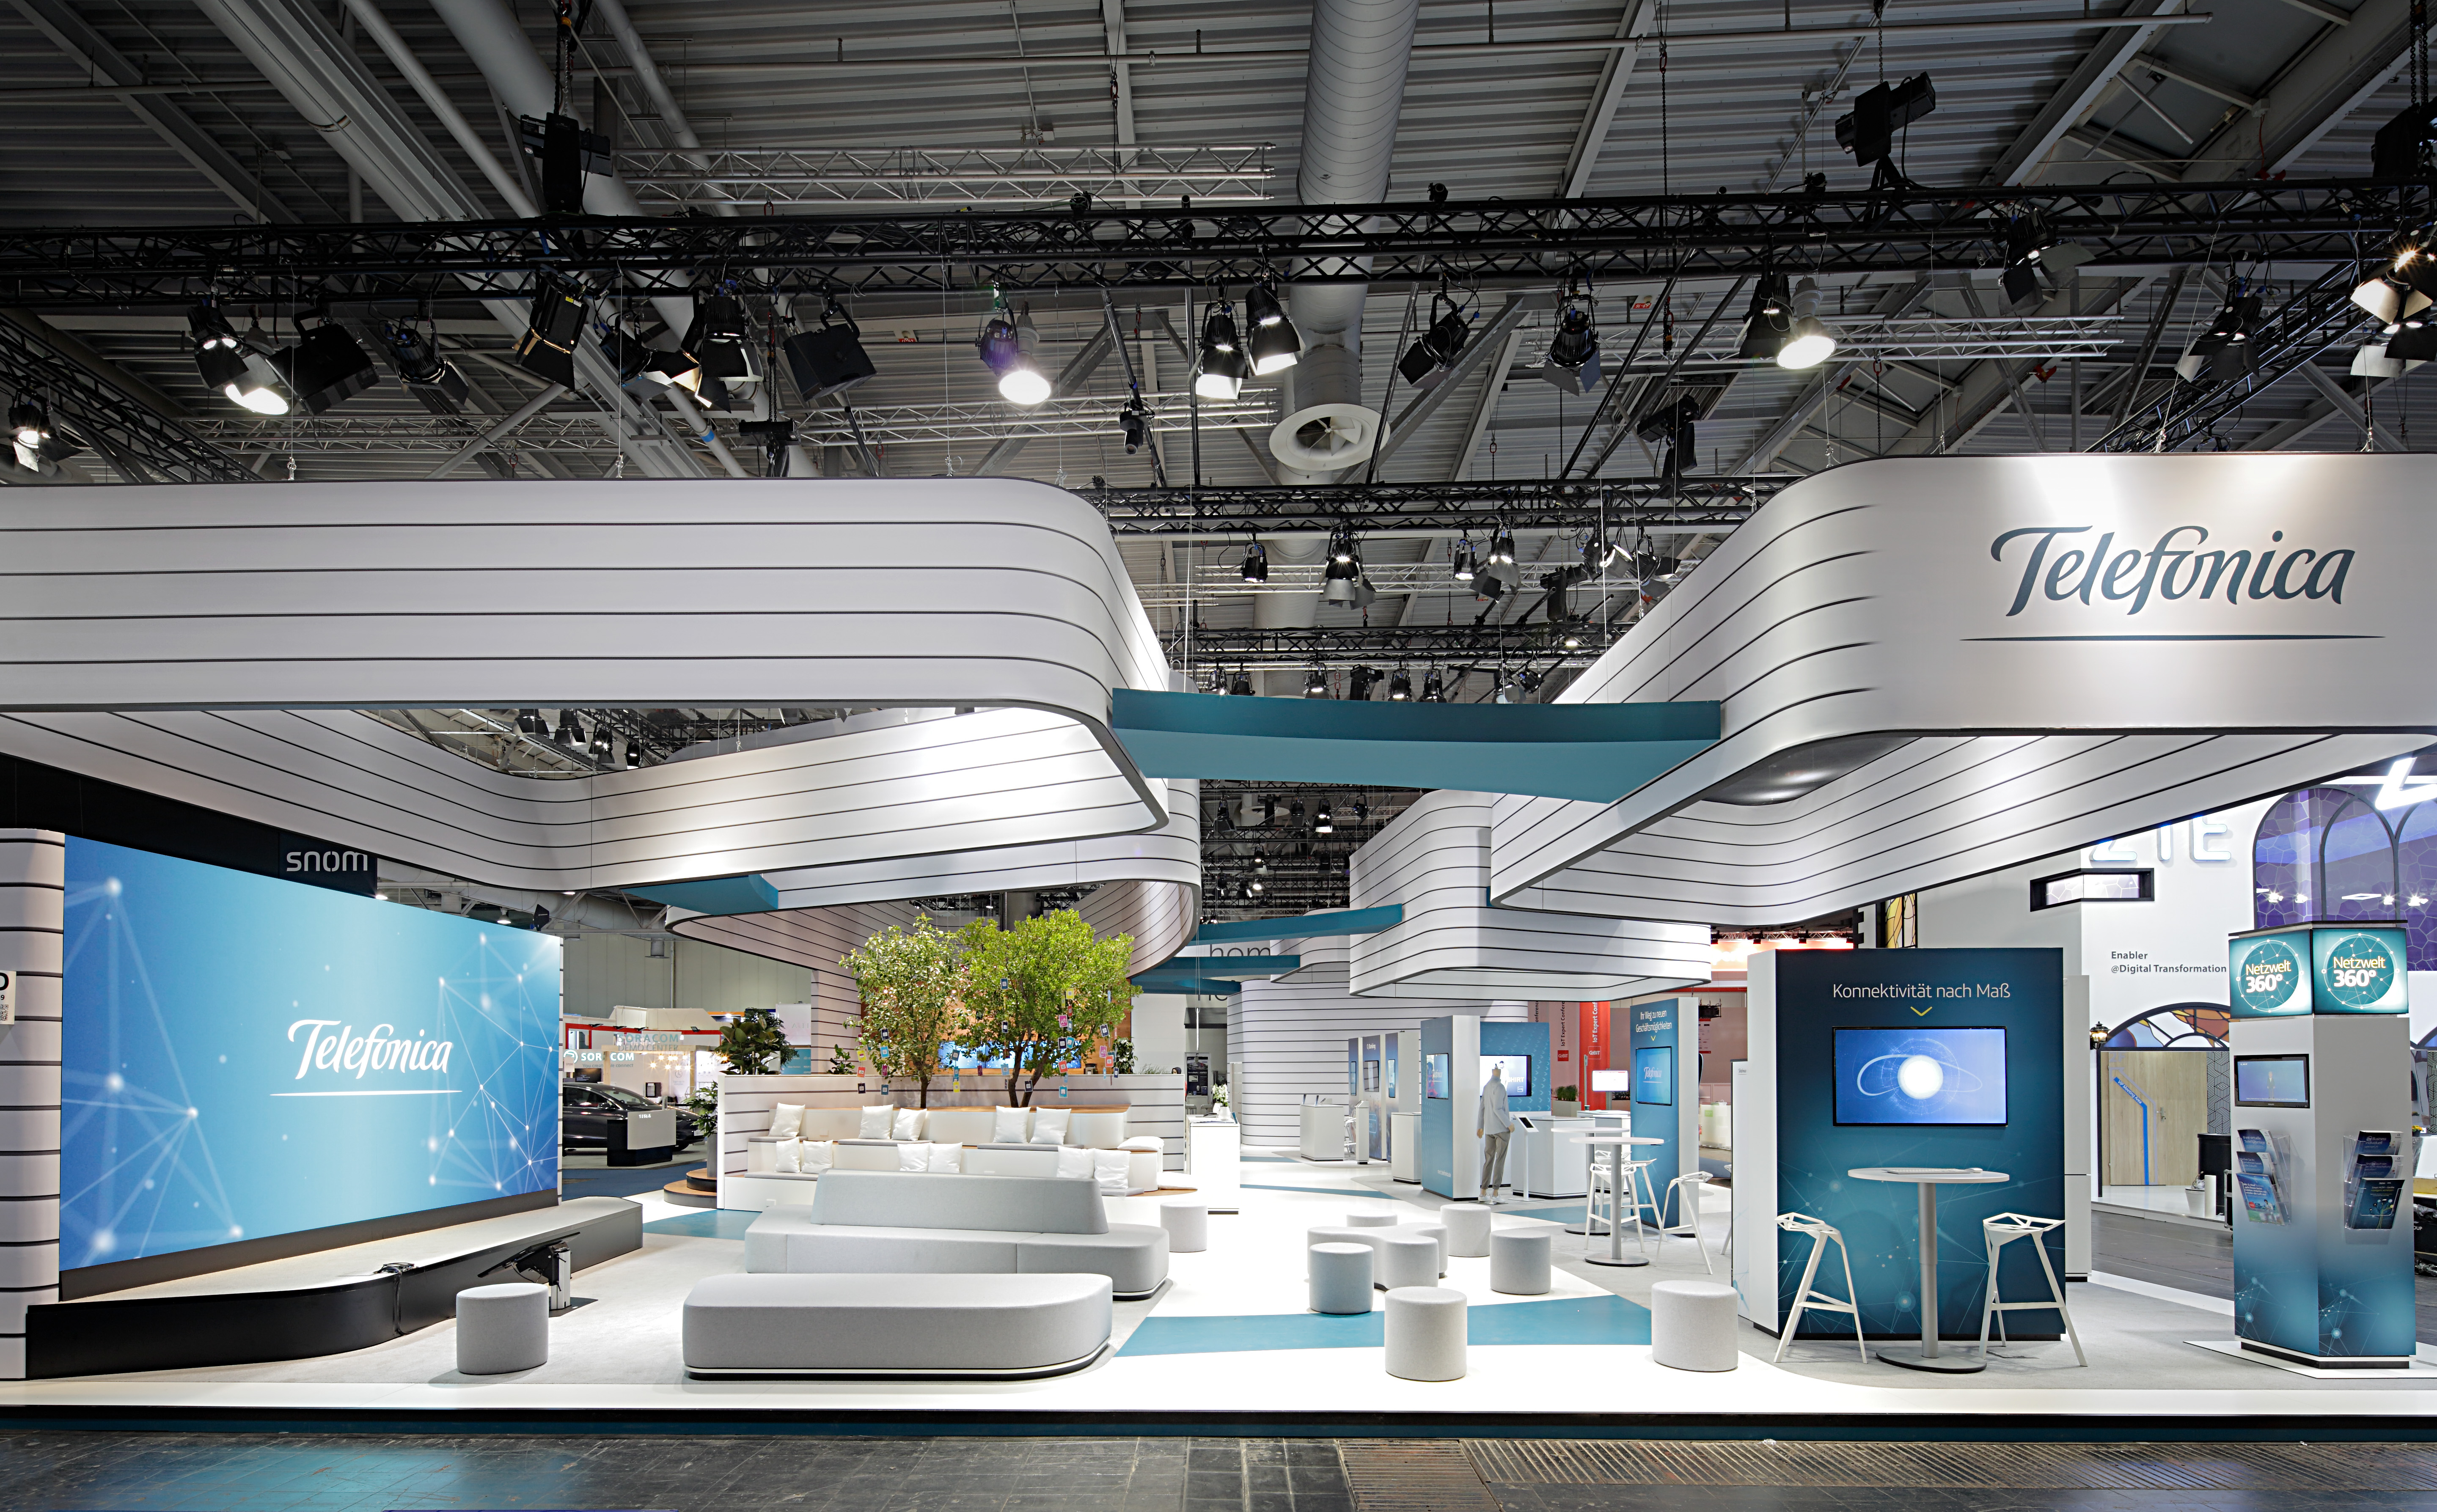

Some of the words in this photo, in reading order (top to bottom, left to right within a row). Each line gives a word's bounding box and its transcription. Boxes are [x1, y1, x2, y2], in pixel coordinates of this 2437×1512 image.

[286, 851, 368, 872] snom
[2111, 951, 2148, 959] Enabler
[2111, 964, 2151, 974] @Digital
[2154, 964, 2227, 972] Transformation
[2245, 959, 2292, 976] Netzwelt
[2333, 956, 2387, 969] Netzwelt
[2246, 973, 2283, 993] 360°
[2333, 969, 2376, 987] 360°
[1833, 983, 1932, 998] Konnektivität
[1936, 983, 1971, 998] nach
[1977, 983, 2011, 998] Maß
[619, 1034, 679, 1042] SORACOM
[581, 1053, 634, 1061] SORCOM
[2123, 1085, 2135, 1098] Meeting
